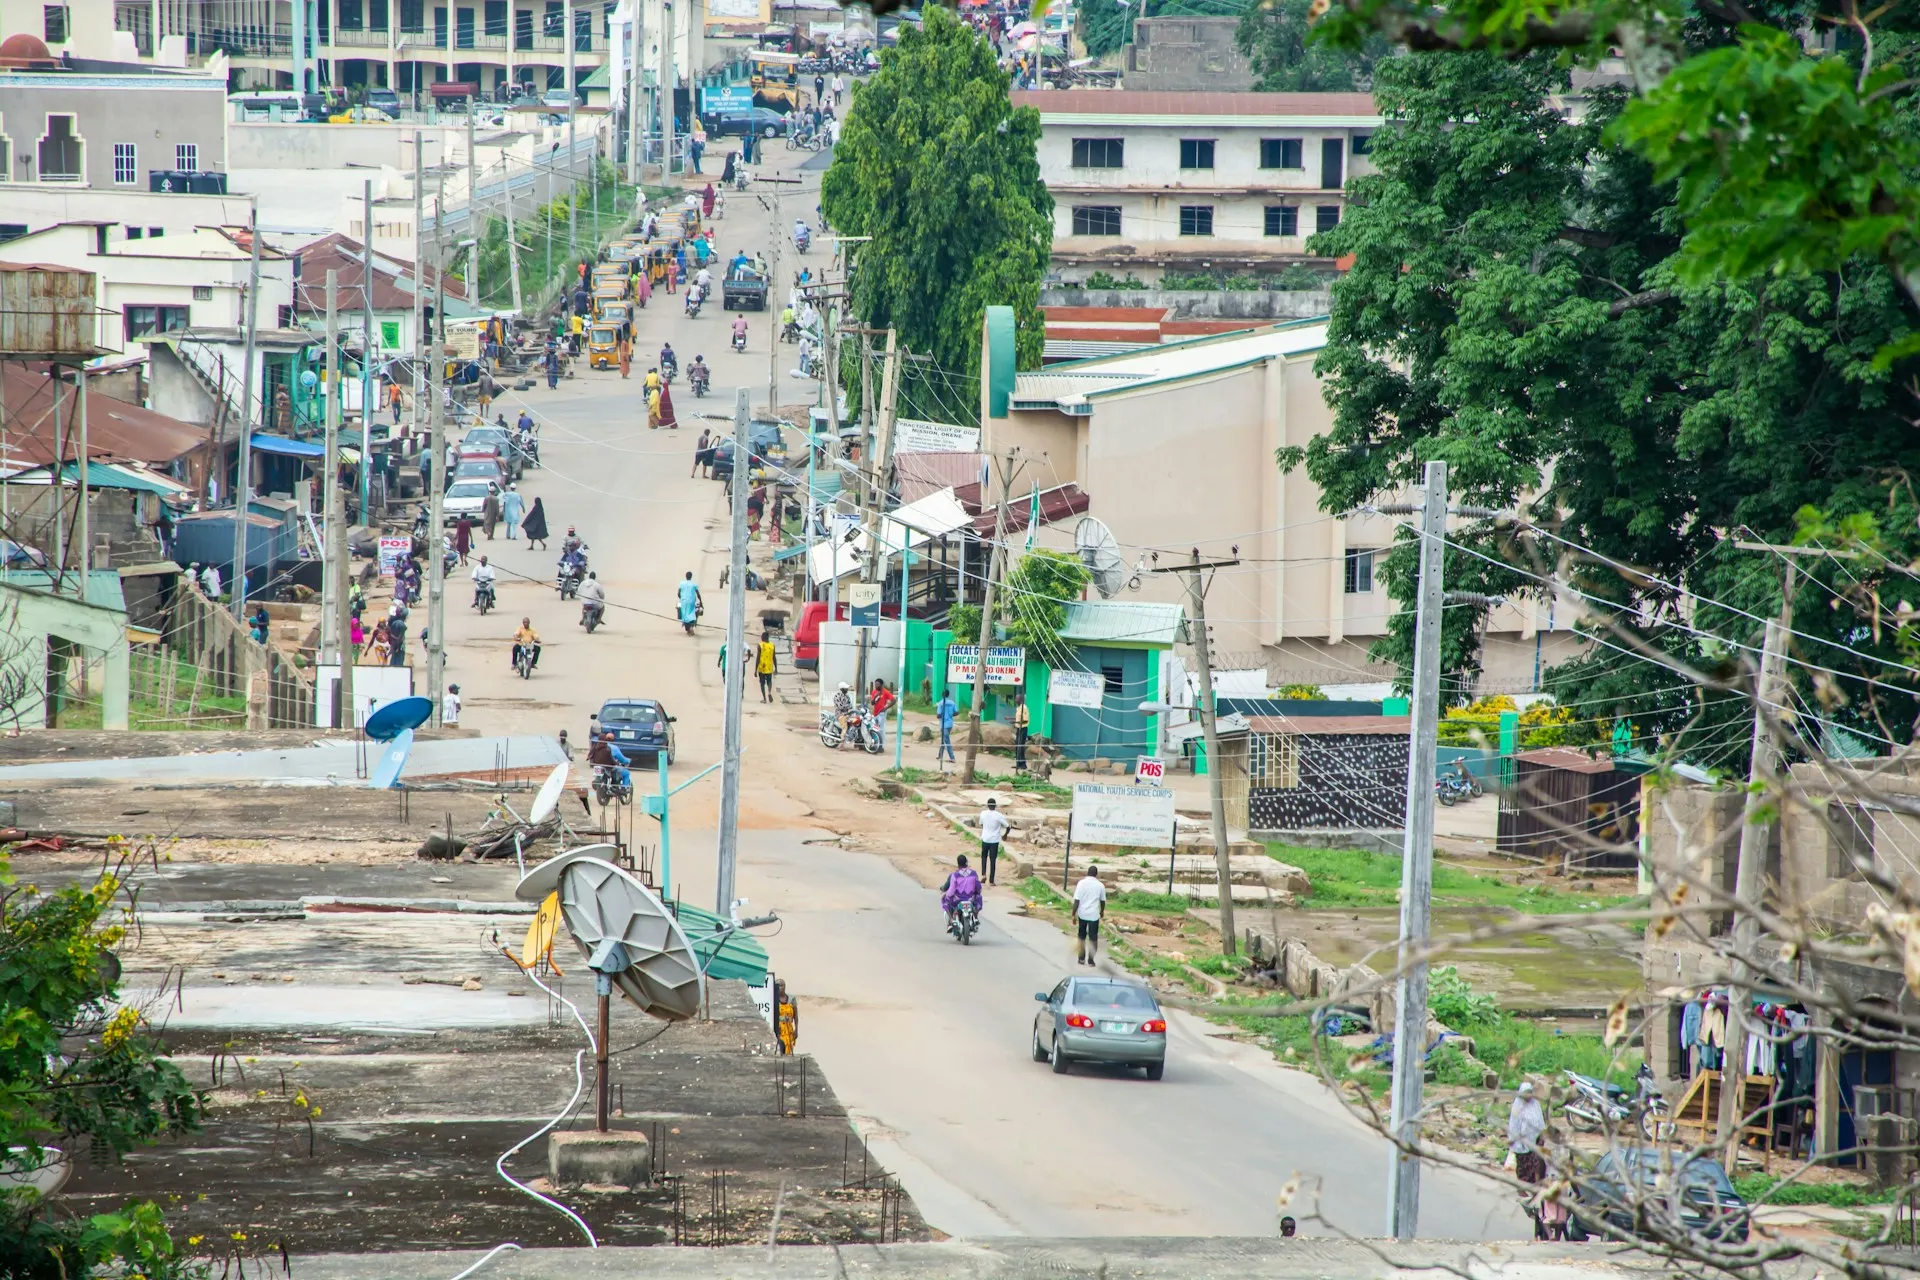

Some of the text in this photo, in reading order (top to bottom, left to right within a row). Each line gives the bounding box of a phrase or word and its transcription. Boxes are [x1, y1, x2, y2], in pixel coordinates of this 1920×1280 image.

[900, 422, 932, 430] PRACTICAL
[952, 645, 1022, 657] LOCAL GERNMENT
[987, 657, 1024, 667] AUTHORITY
[955, 665, 960, 673] P
[962, 665, 969, 673] M
[1140, 762, 1162, 777] POS
[1078, 784, 1172, 798] NATIONAL YOUTH SERVICE CORPS
